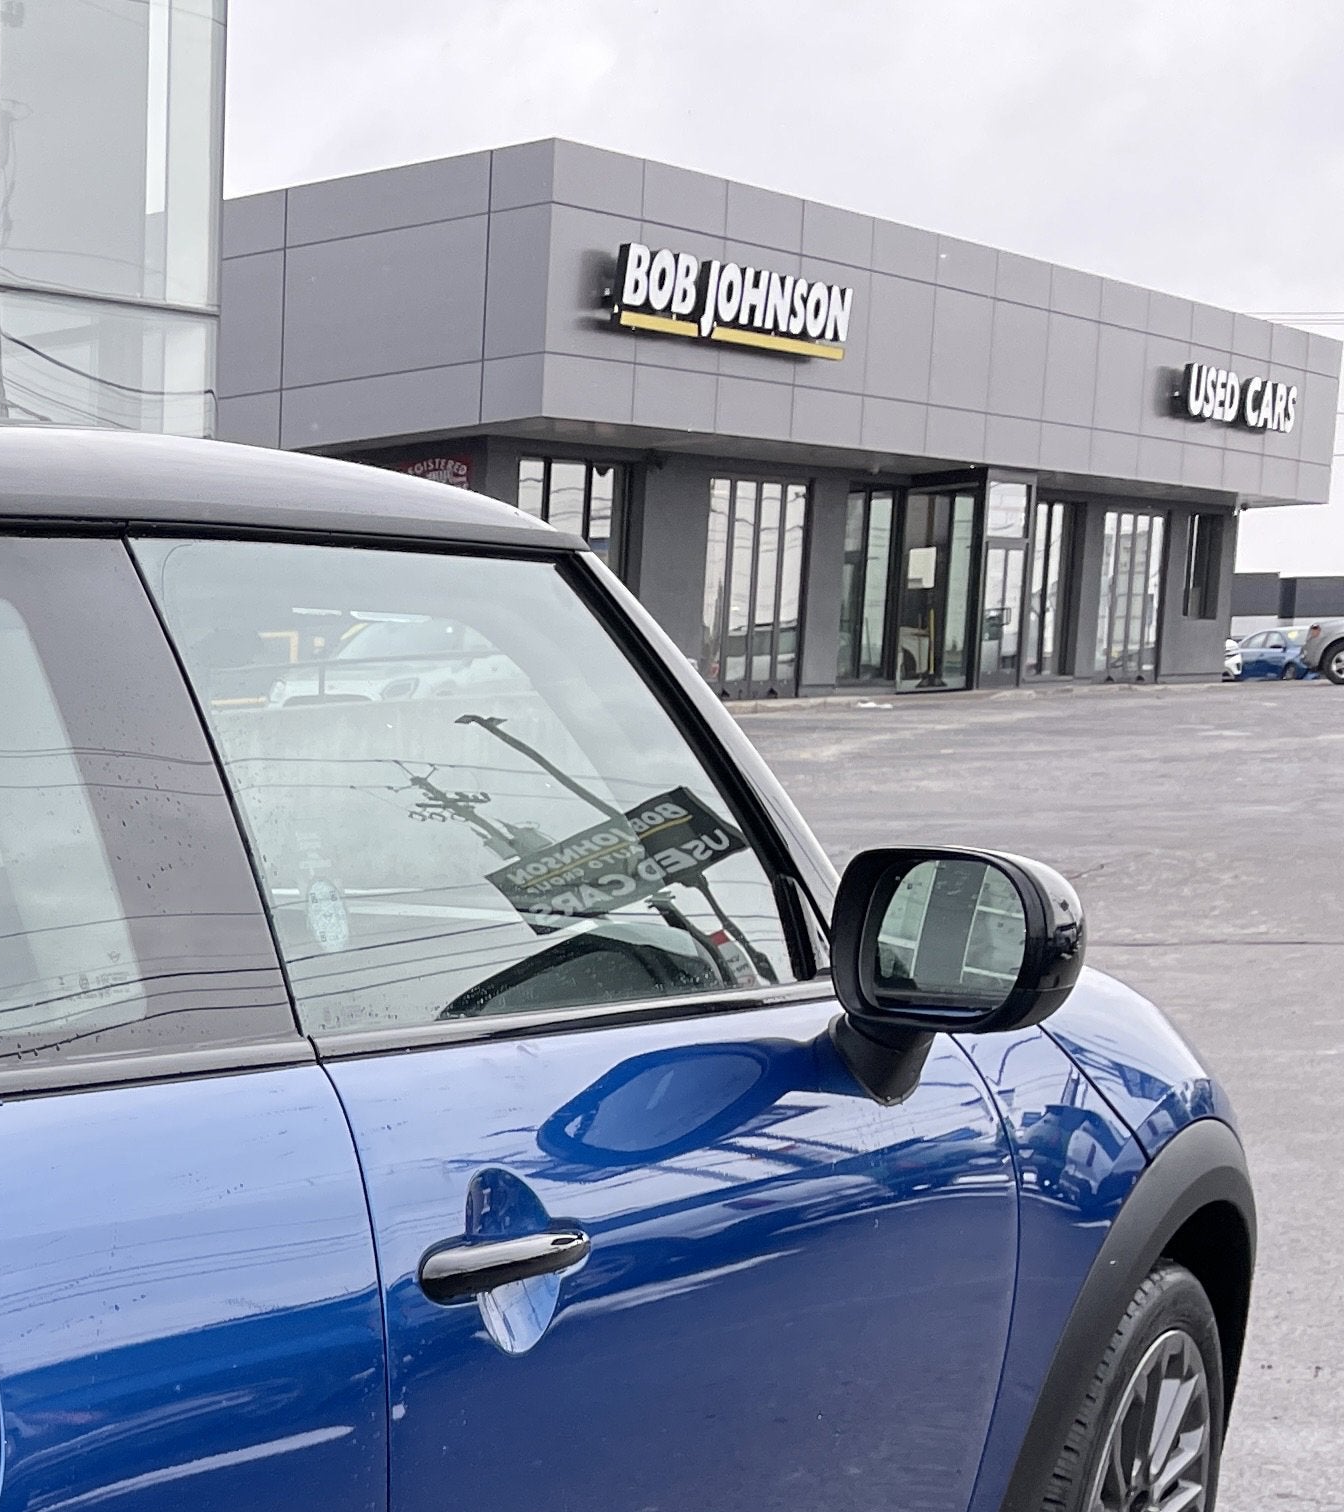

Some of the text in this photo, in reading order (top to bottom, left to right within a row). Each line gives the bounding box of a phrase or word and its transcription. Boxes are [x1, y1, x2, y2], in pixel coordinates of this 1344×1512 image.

[623, 242, 853, 342] BOB JOHNSON
[1188, 362, 1298, 433] USED CARS
